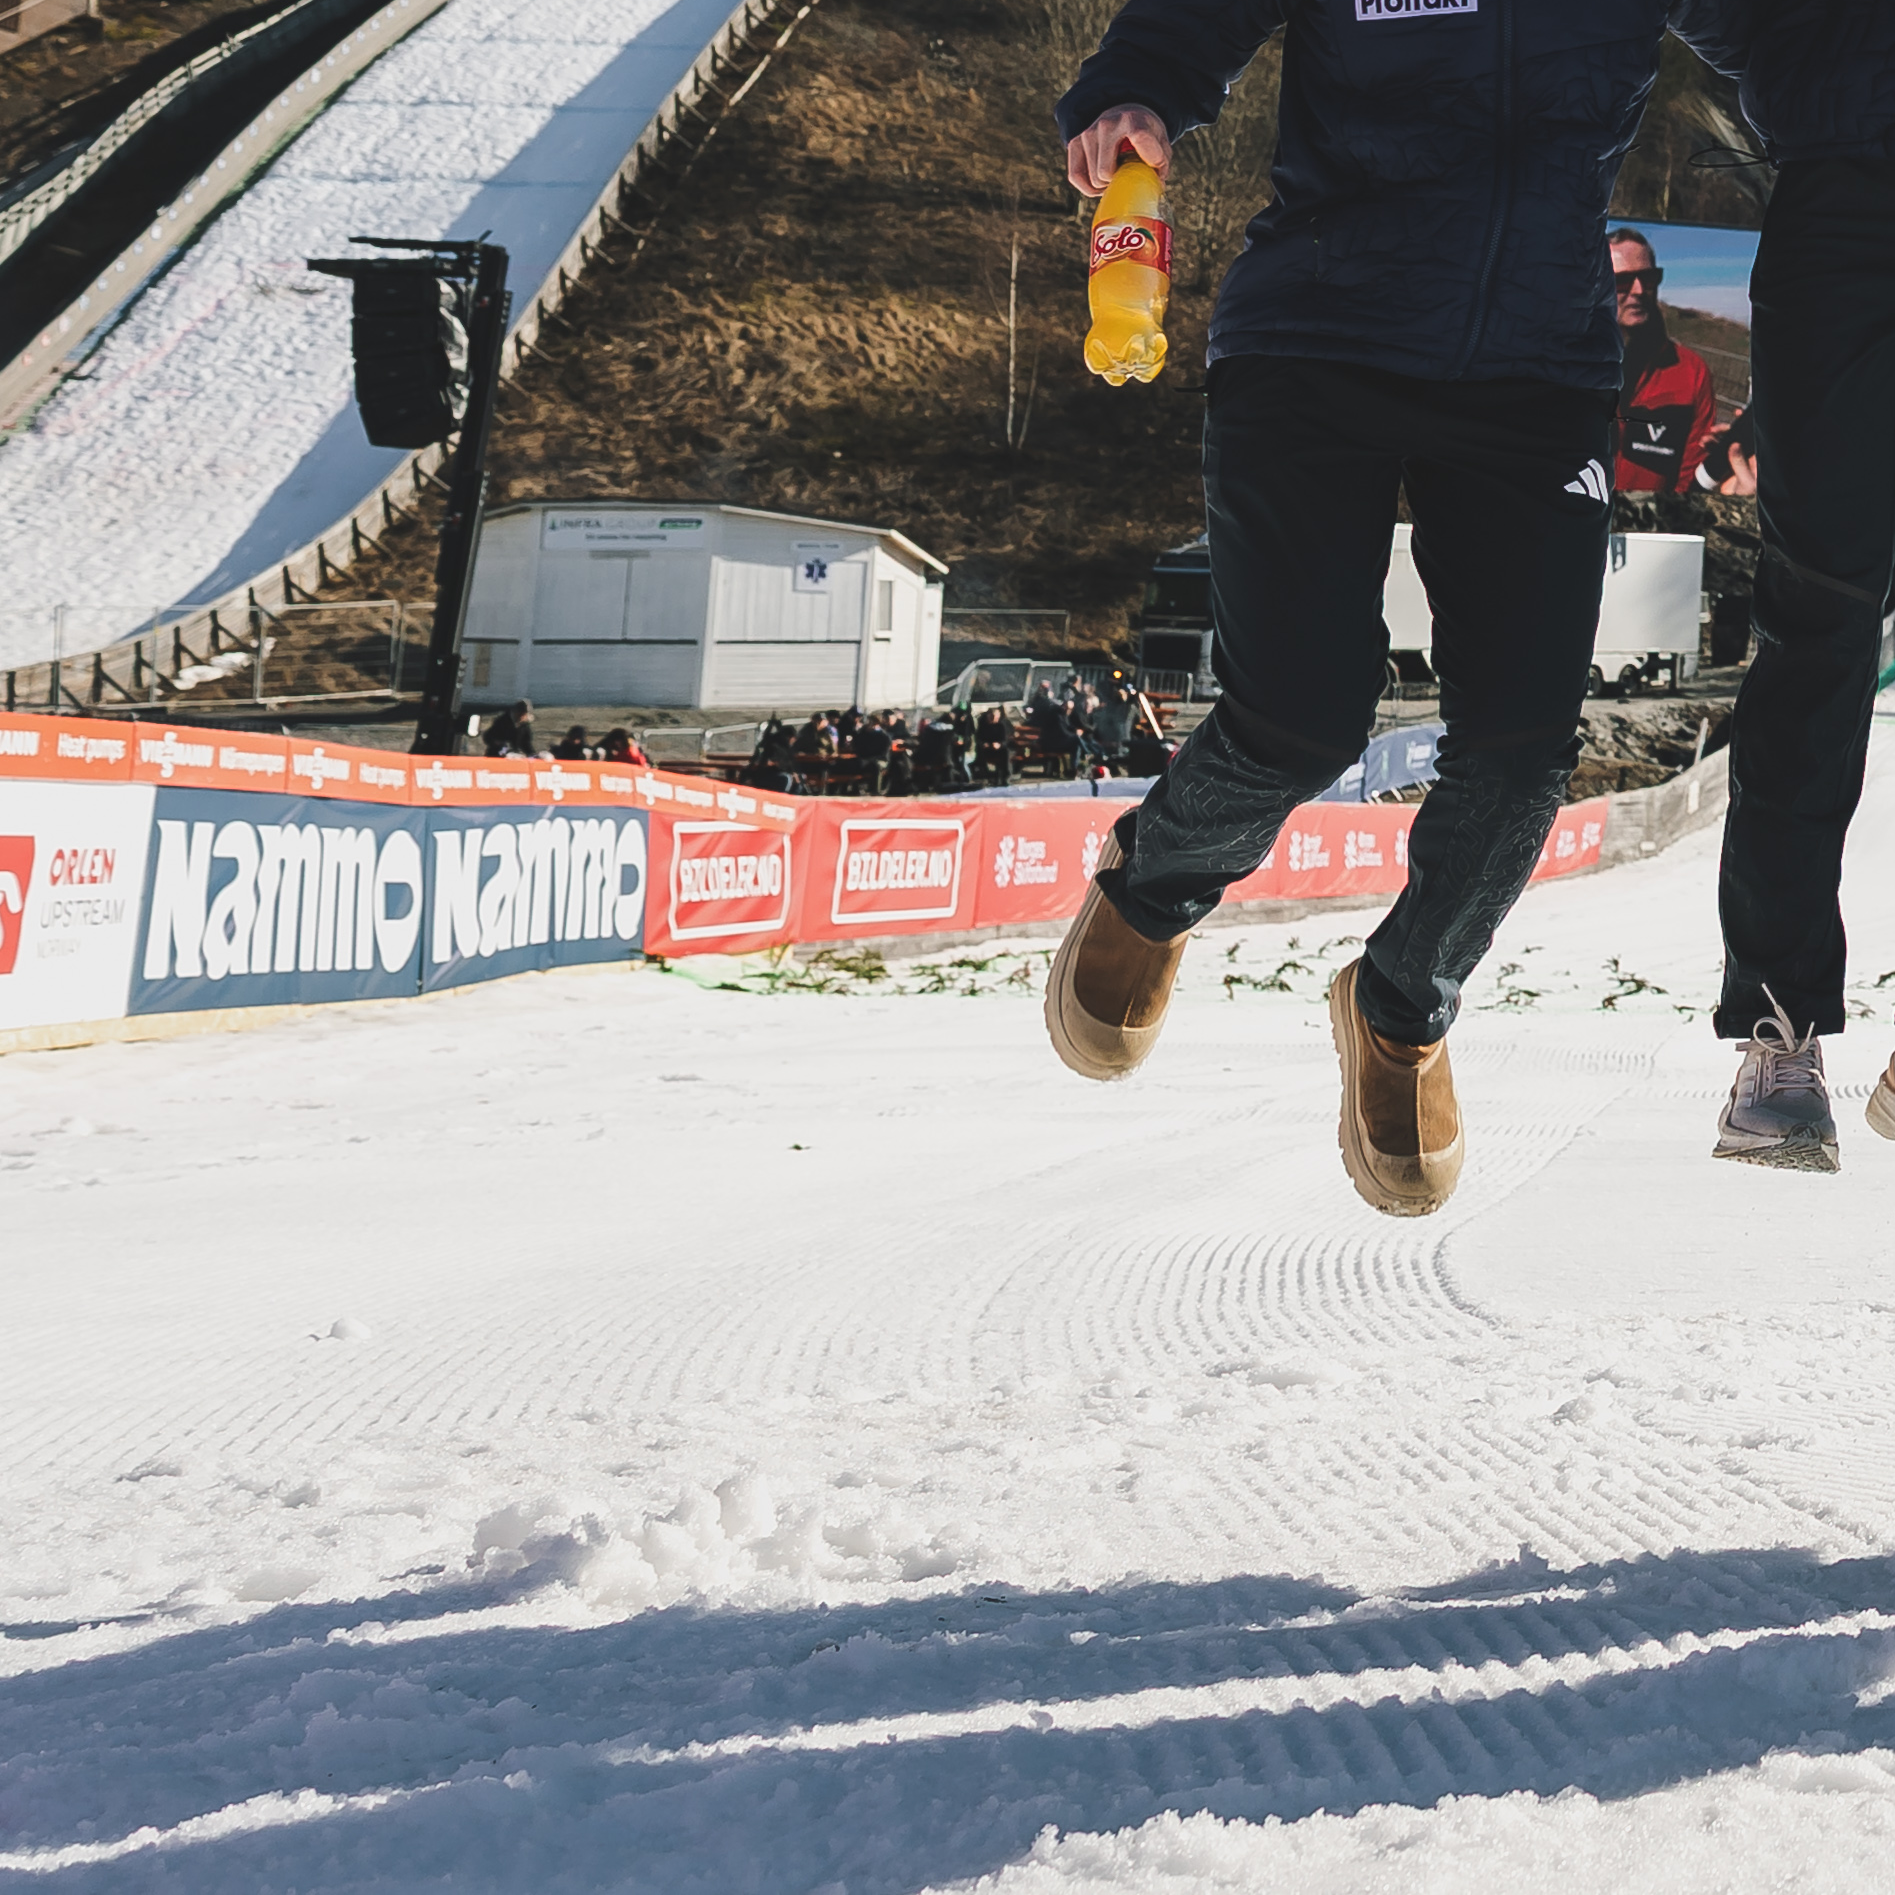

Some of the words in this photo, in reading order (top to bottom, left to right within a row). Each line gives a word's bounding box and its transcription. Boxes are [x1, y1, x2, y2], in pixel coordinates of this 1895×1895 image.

[50, 848, 117, 886] ORLEN
[40, 898, 126, 929] UPSTREAM
[144, 818, 423, 981] Nammo
[432, 816, 648, 965] Nammo
